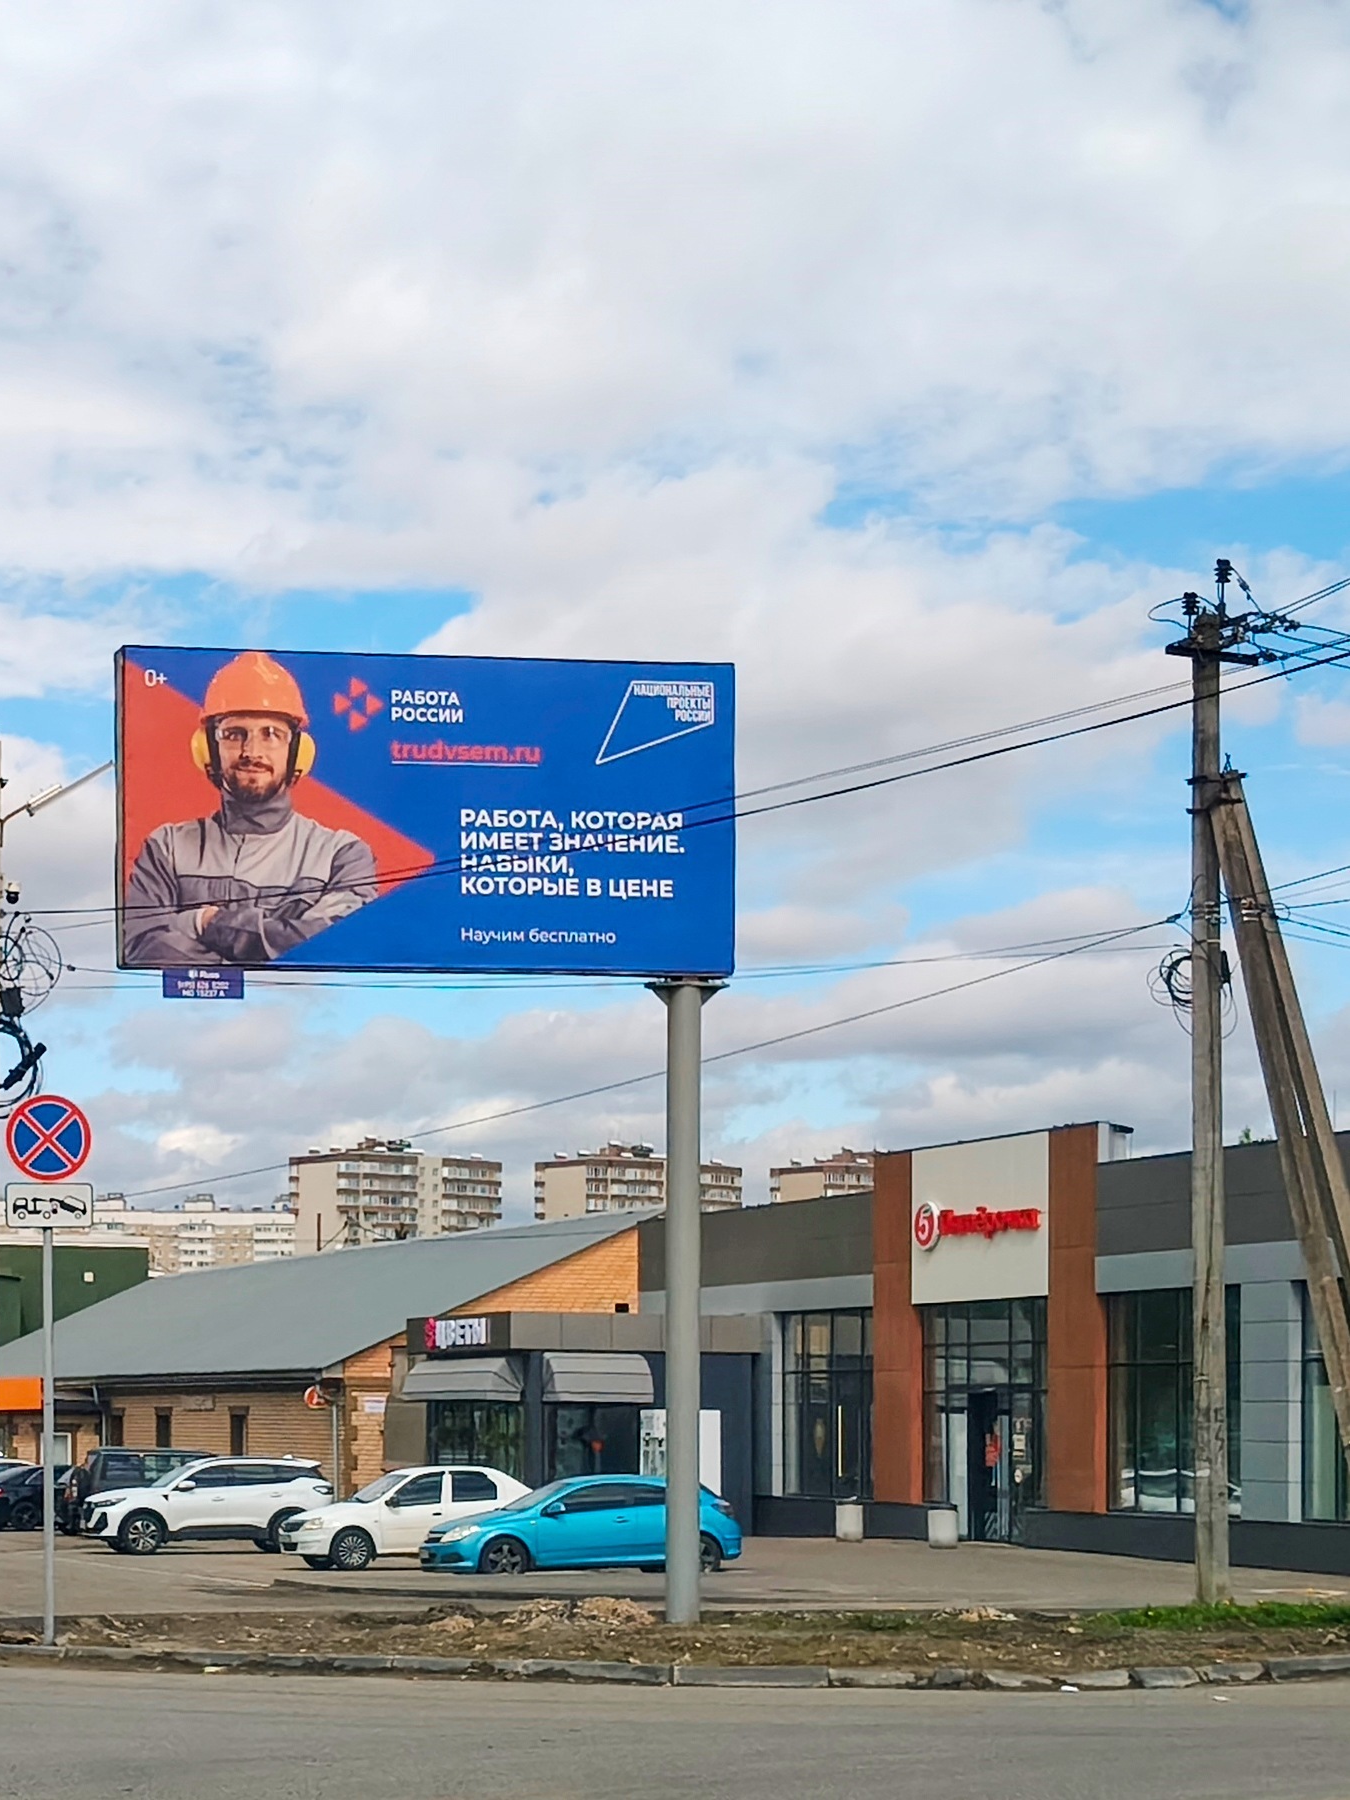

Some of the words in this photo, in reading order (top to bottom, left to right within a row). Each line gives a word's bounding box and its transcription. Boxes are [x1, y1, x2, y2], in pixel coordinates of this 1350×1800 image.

[144, 669, 168, 687] 0+
[390, 689, 461, 706] РАБОТА
[633, 684, 711, 697] НАЦИОНАЛЬНЫЕ
[667, 697, 711, 709] ПРОЕКТЫ
[390, 707, 464, 723] РОССИИ
[675, 709, 711, 722] РОССИИ
[390, 740, 542, 763] trudvsem.ru
[460, 808, 565, 832] РАБОТА,
[571, 811, 683, 830] КОТОРАЯ
[460, 831, 543, 851] ИМЕЕТ
[549, 833, 686, 853] ЗНАЧЕНИЕ.
[460, 853, 575, 876] НАВЫКИ,
[460, 876, 580, 896] КОТОРЫЕ
[586, 879, 602, 896] В
[608, 879, 674, 900] ЦЕНЕ
[460, 928, 525, 945] Научим
[528, 928, 617, 944] бесплатно
